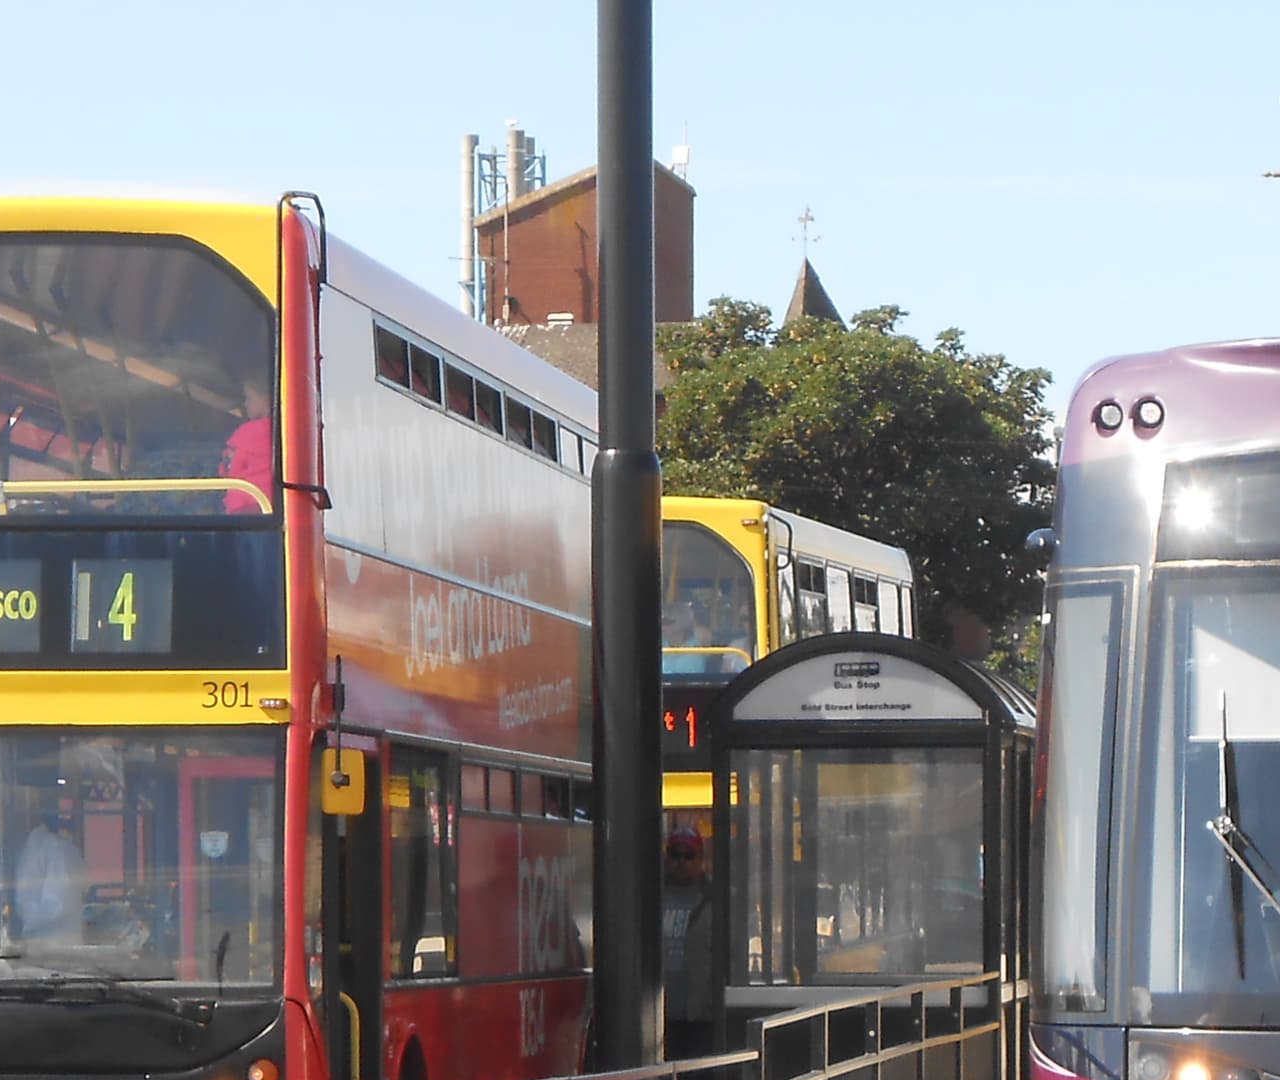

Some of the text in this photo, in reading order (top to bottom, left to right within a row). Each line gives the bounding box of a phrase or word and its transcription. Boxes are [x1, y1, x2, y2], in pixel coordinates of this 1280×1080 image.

[833, 679, 881, 690] Bus Stop
[201, 681, 254, 708] 301
[824, 703, 853, 711] Street
[855, 701, 912, 712] Interchange
